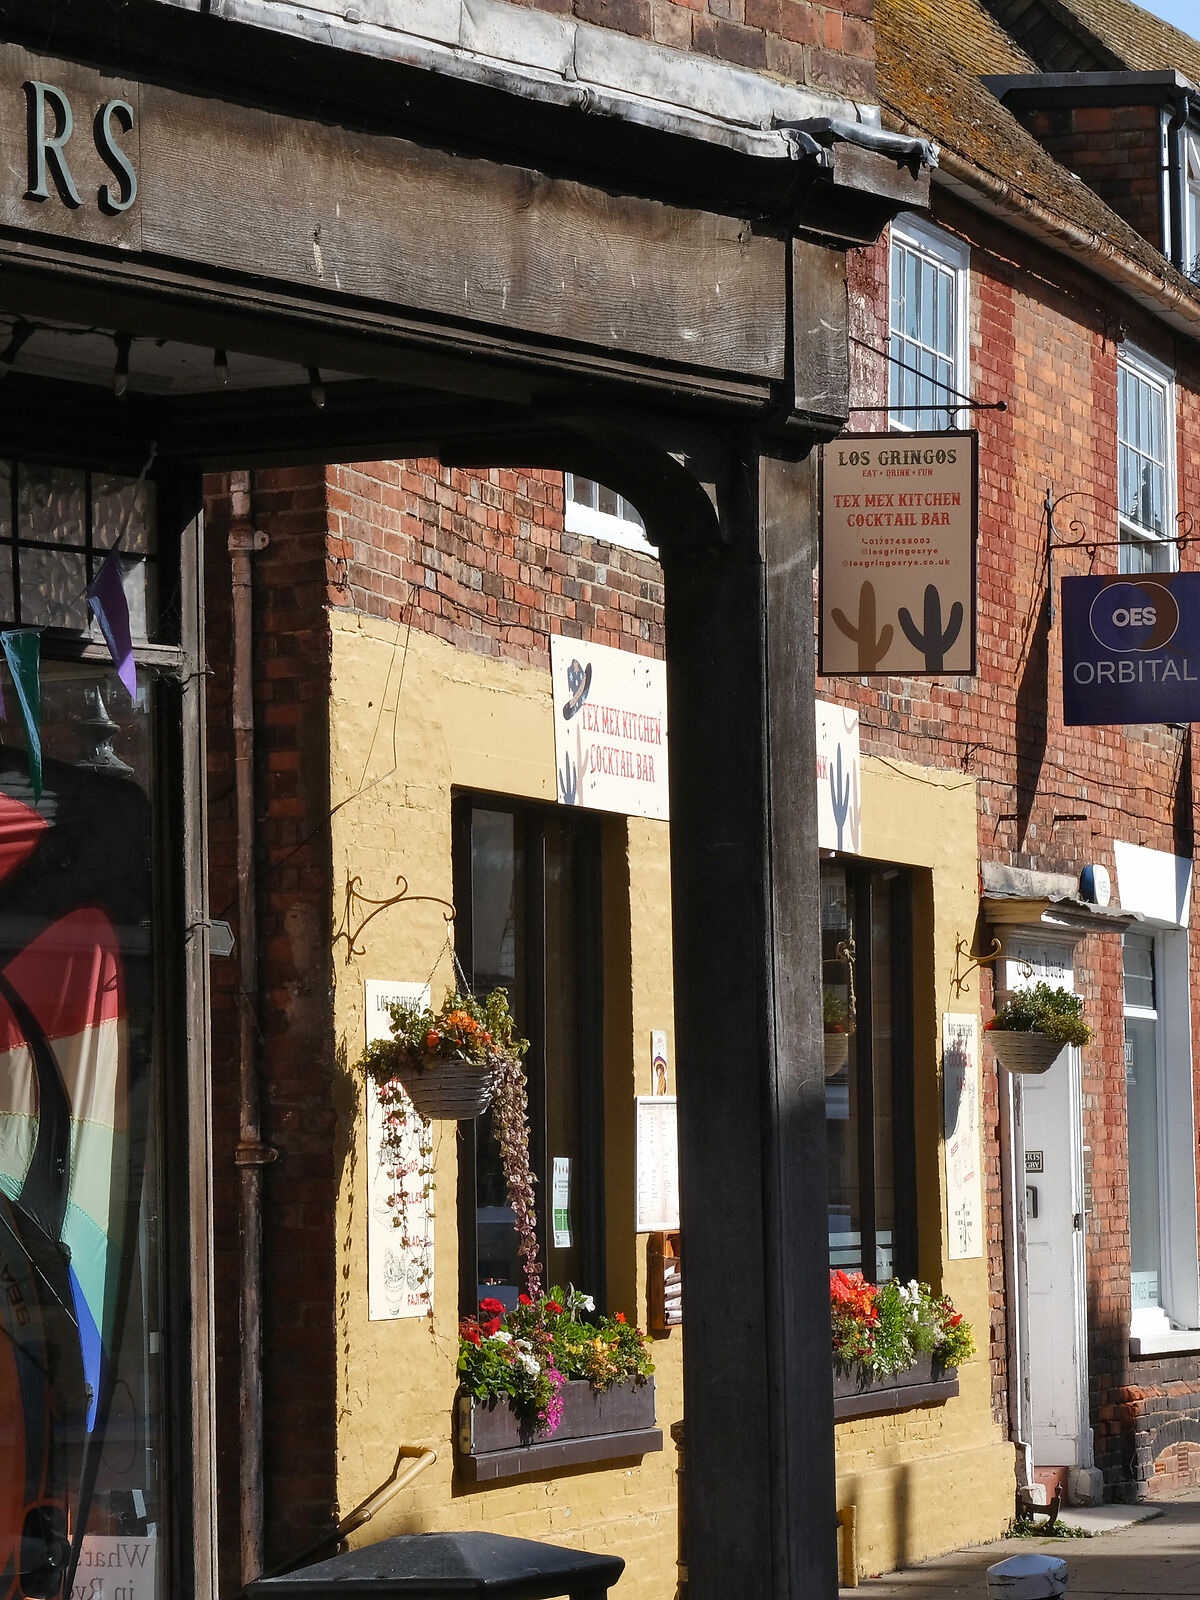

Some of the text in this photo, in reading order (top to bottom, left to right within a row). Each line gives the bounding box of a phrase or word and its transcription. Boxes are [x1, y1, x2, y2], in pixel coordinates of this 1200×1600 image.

[838, 449, 957, 466] LOS GRINGOS
[862, 469, 933, 477] EAT DRINK FUN
[833, 492, 961, 508] TEX MEX KITCHEN
[847, 512, 951, 527] COCKTAIL BAR
[1112, 606, 1157, 627] OES
[1073, 658, 1198, 685] ORBITAL
[582, 702, 662, 745] TEX MEX KITCHEN
[590, 743, 656, 783] COCKTAIL BAR
